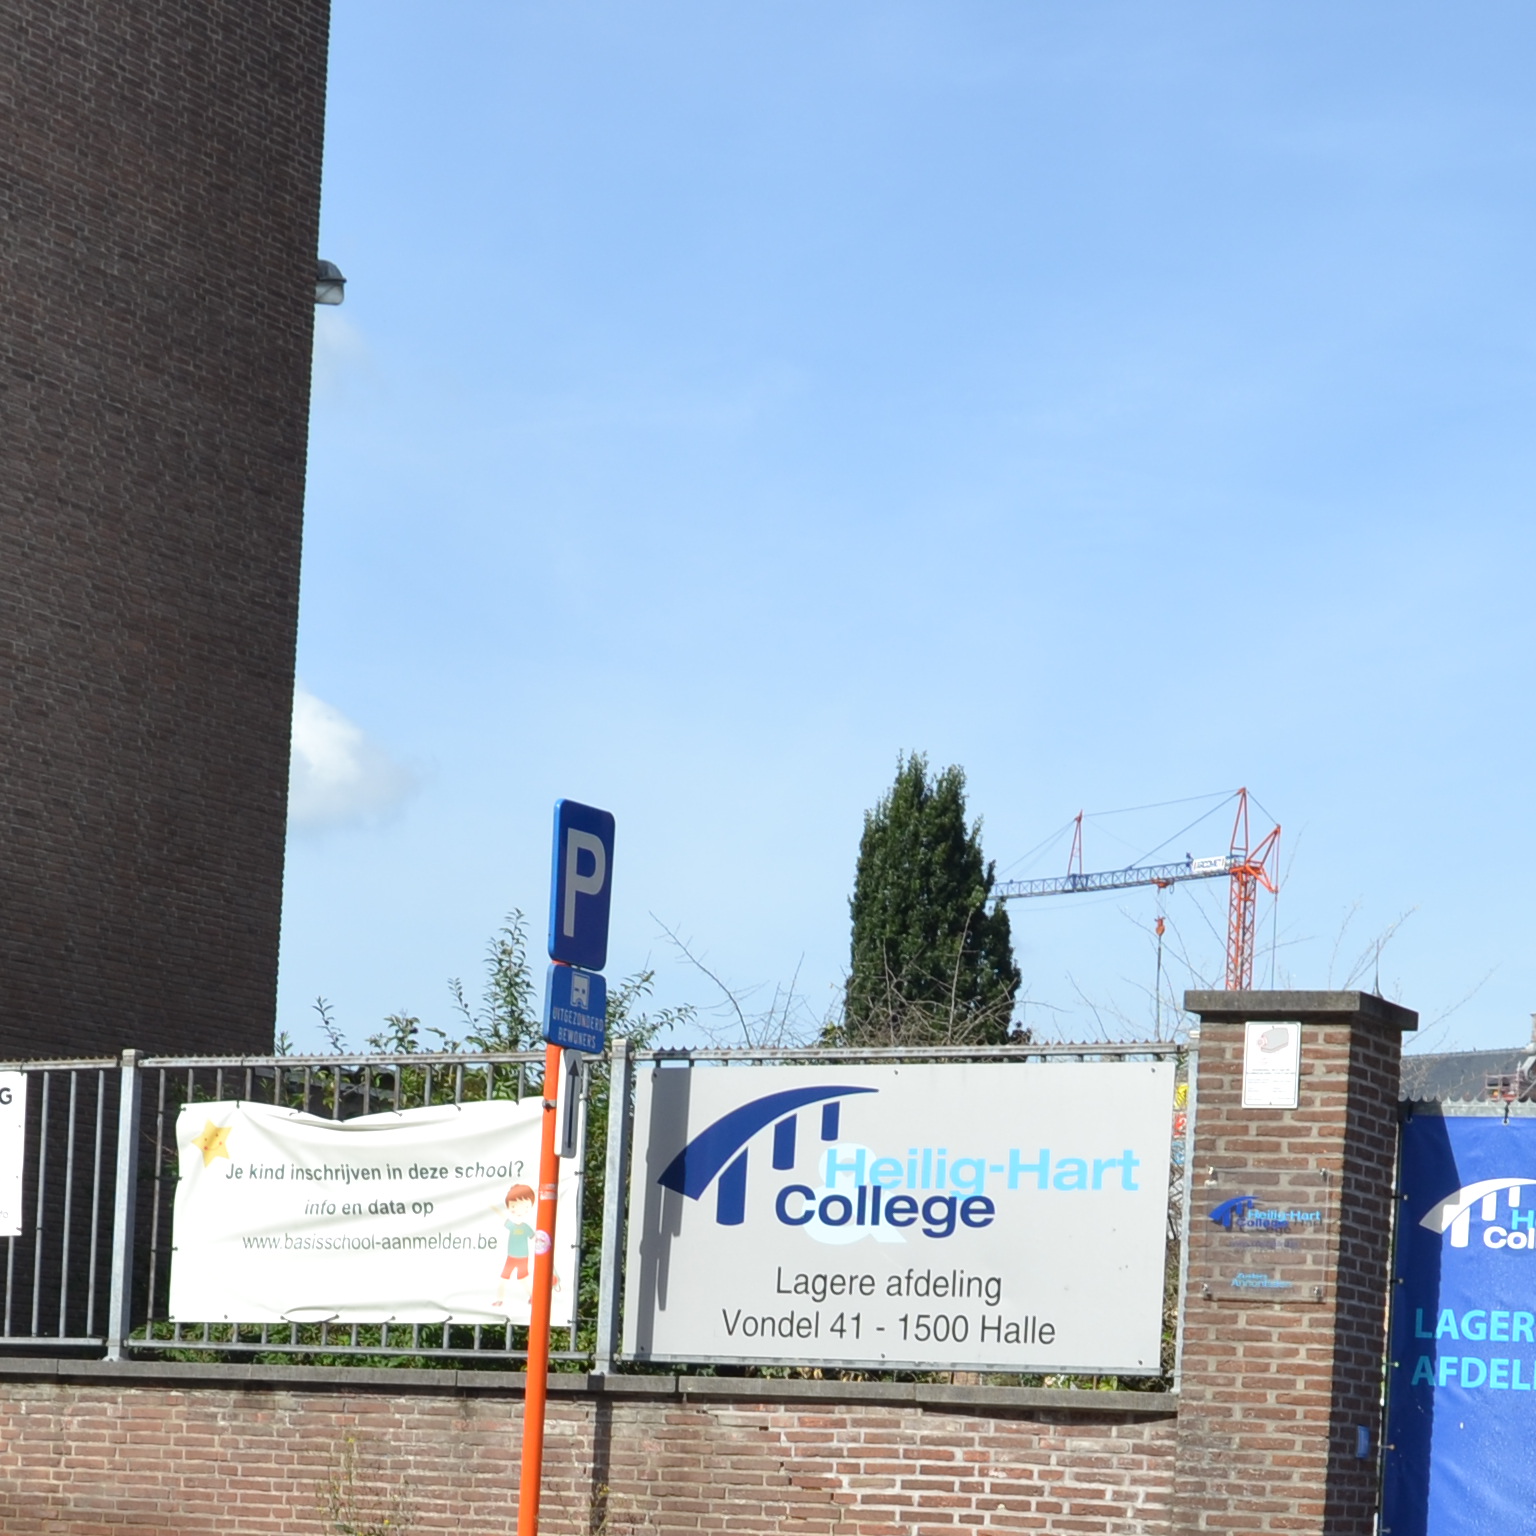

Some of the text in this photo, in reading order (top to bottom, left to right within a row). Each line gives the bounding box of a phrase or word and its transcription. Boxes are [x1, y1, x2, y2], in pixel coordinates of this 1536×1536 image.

[563, 826, 606, 938] P
[552, 1007, 604, 1032] UITGEZONDERD
[557, 1027, 596, 1049] BEWONERS
[226, 1161, 524, 1185] Je kind inschrijven in deze school?
[825, 1147, 1140, 1198] Heilig-Hart
[304, 1199, 434, 1217] info en data op
[775, 1184, 995, 1238] College
[1247, 1208, 1321, 1222] Heilig-Hart
[242, 1233, 498, 1251] www.basisschool-aanmelden.be
[776, 1267, 1002, 1305] Lagere afdeling
[722, 1309, 819, 1339] Vondel
[829, 1312, 862, 1340] 41
[898, 1313, 968, 1344] 1500
[980, 1315, 1056, 1346] Halle
